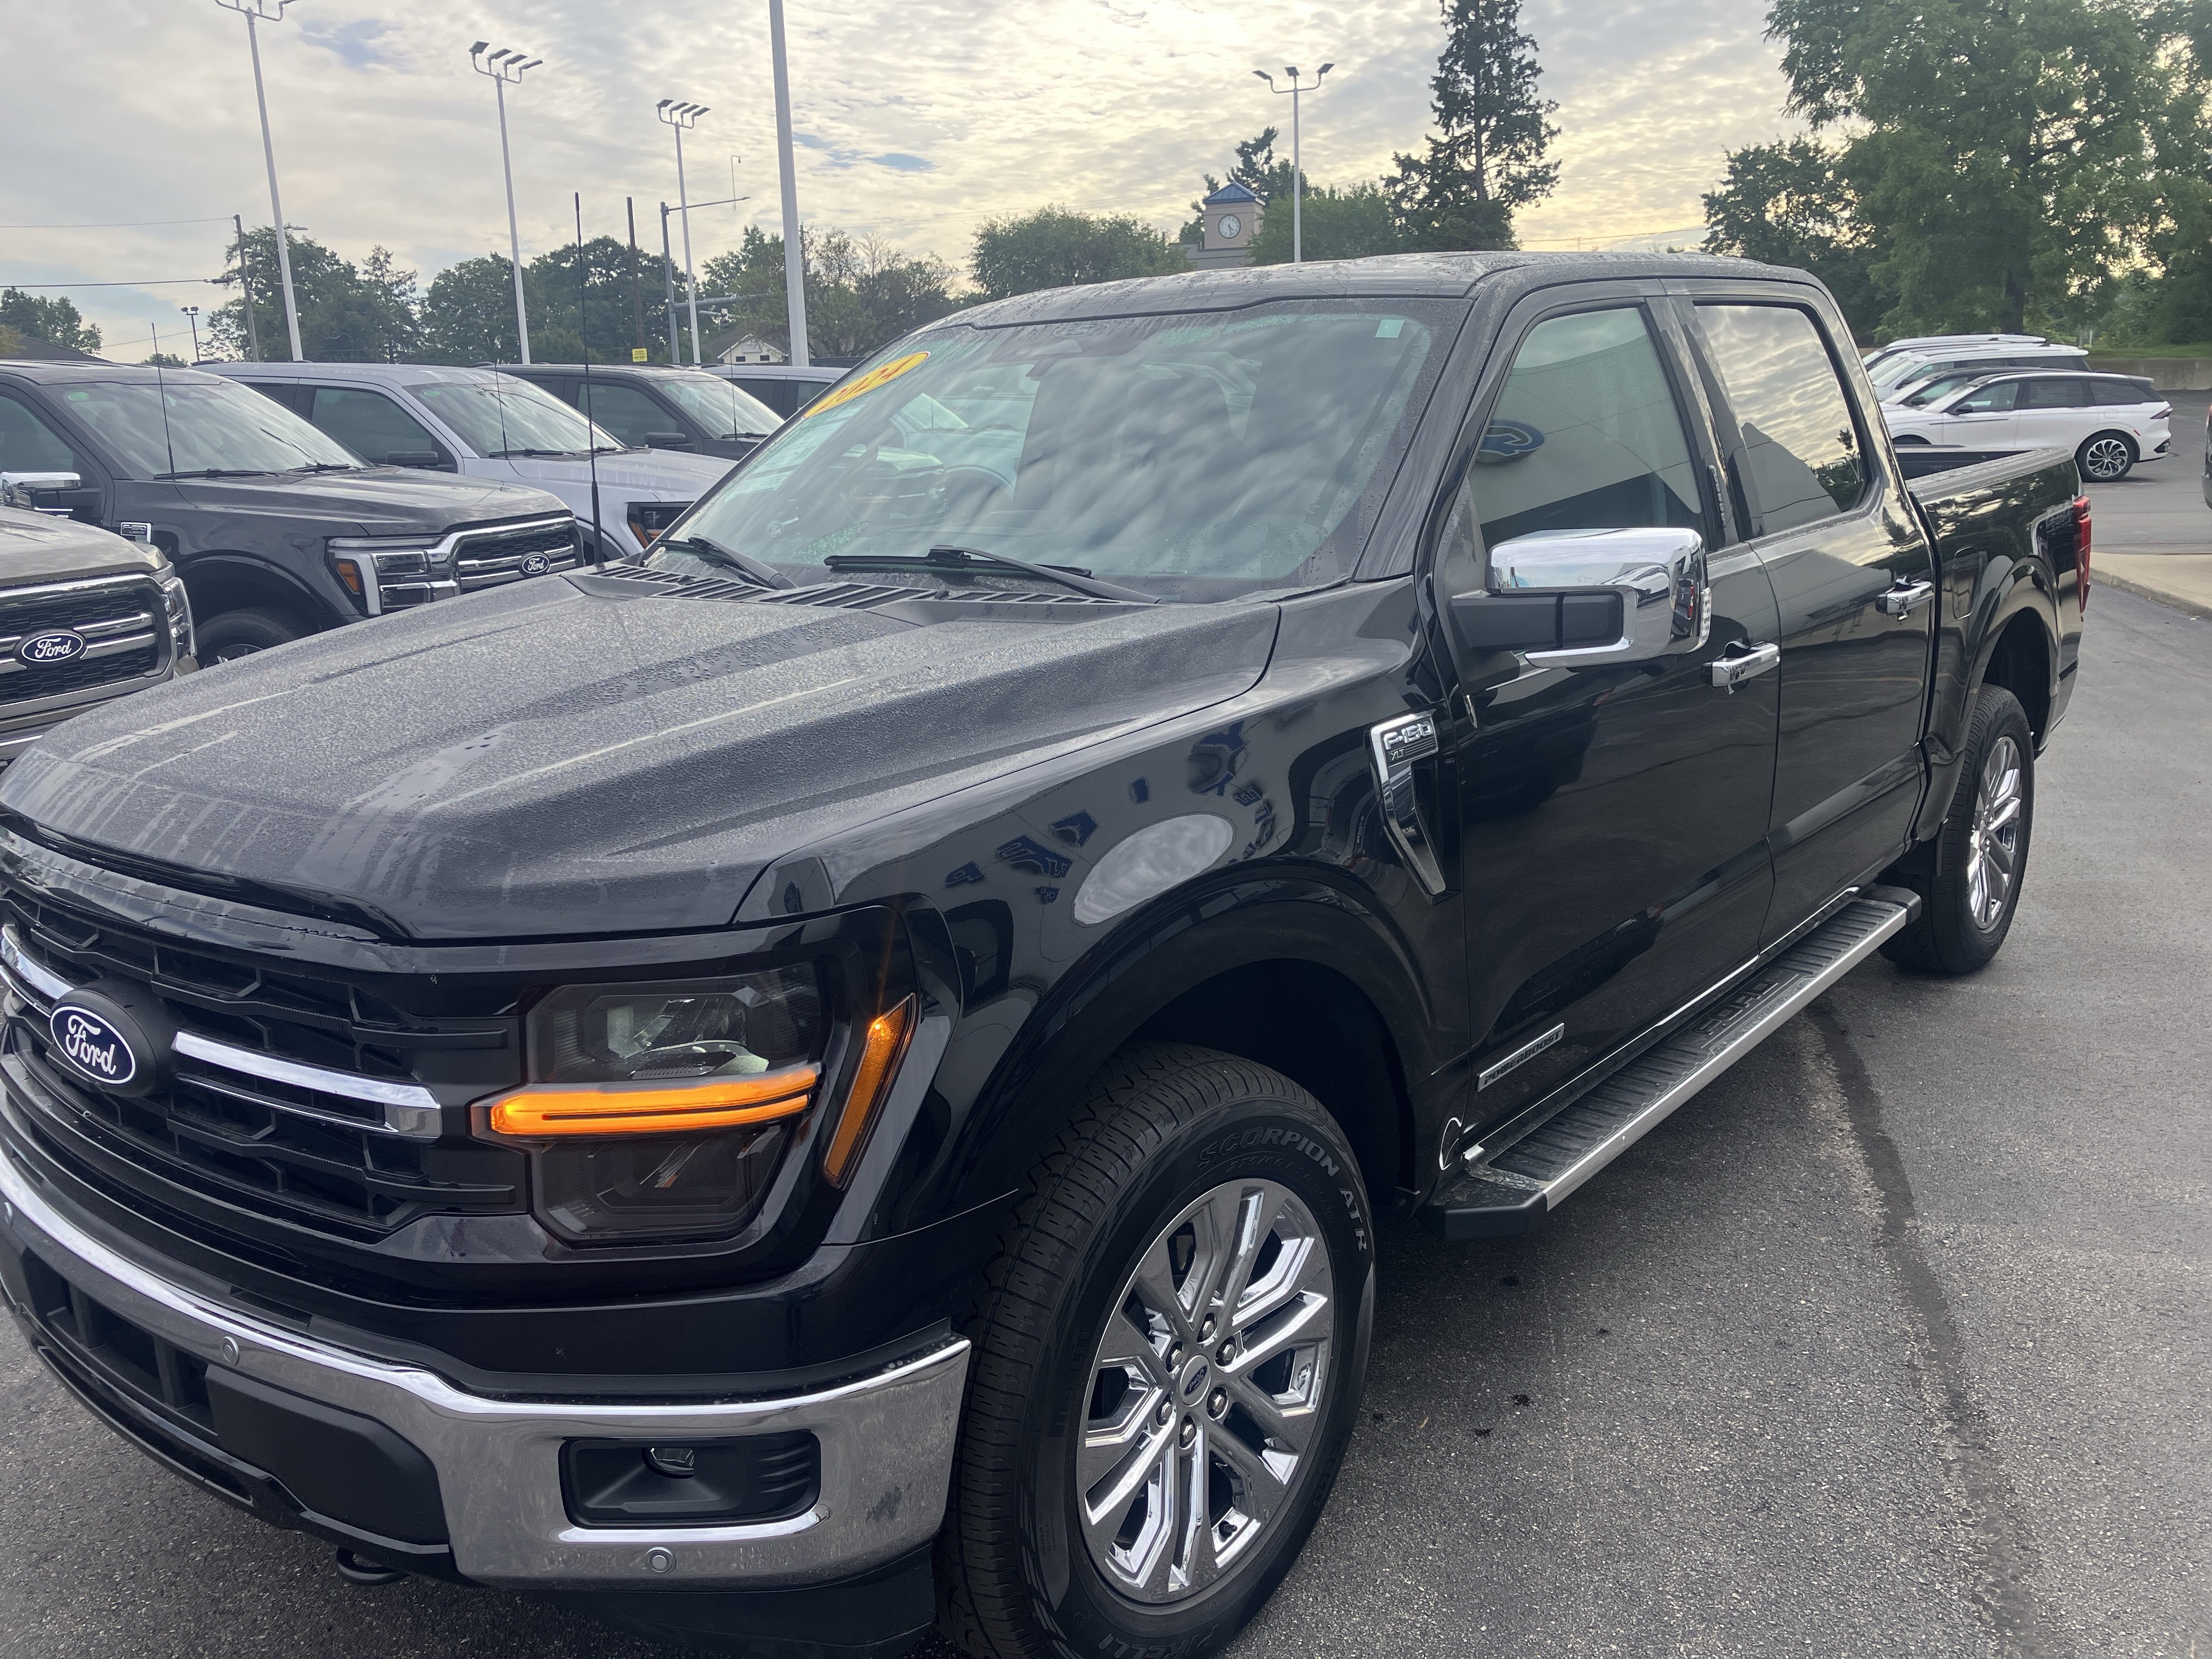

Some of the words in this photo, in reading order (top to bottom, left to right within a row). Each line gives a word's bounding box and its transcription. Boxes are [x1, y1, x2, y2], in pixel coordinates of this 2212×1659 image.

[528, 557, 545, 571] Ford
[35, 637, 72, 658] Ford
[1383, 721, 1434, 750] F-150
[1390, 748, 1404, 761] XLT
[1690, 979, 1779, 1036] FORD
[65, 1014, 117, 1075] Ford
[1483, 1029, 1561, 1086] POWERBOOST
[1198, 1126, 1340, 1177] SCORPION
[1339, 1188, 1368, 1252] ATR
